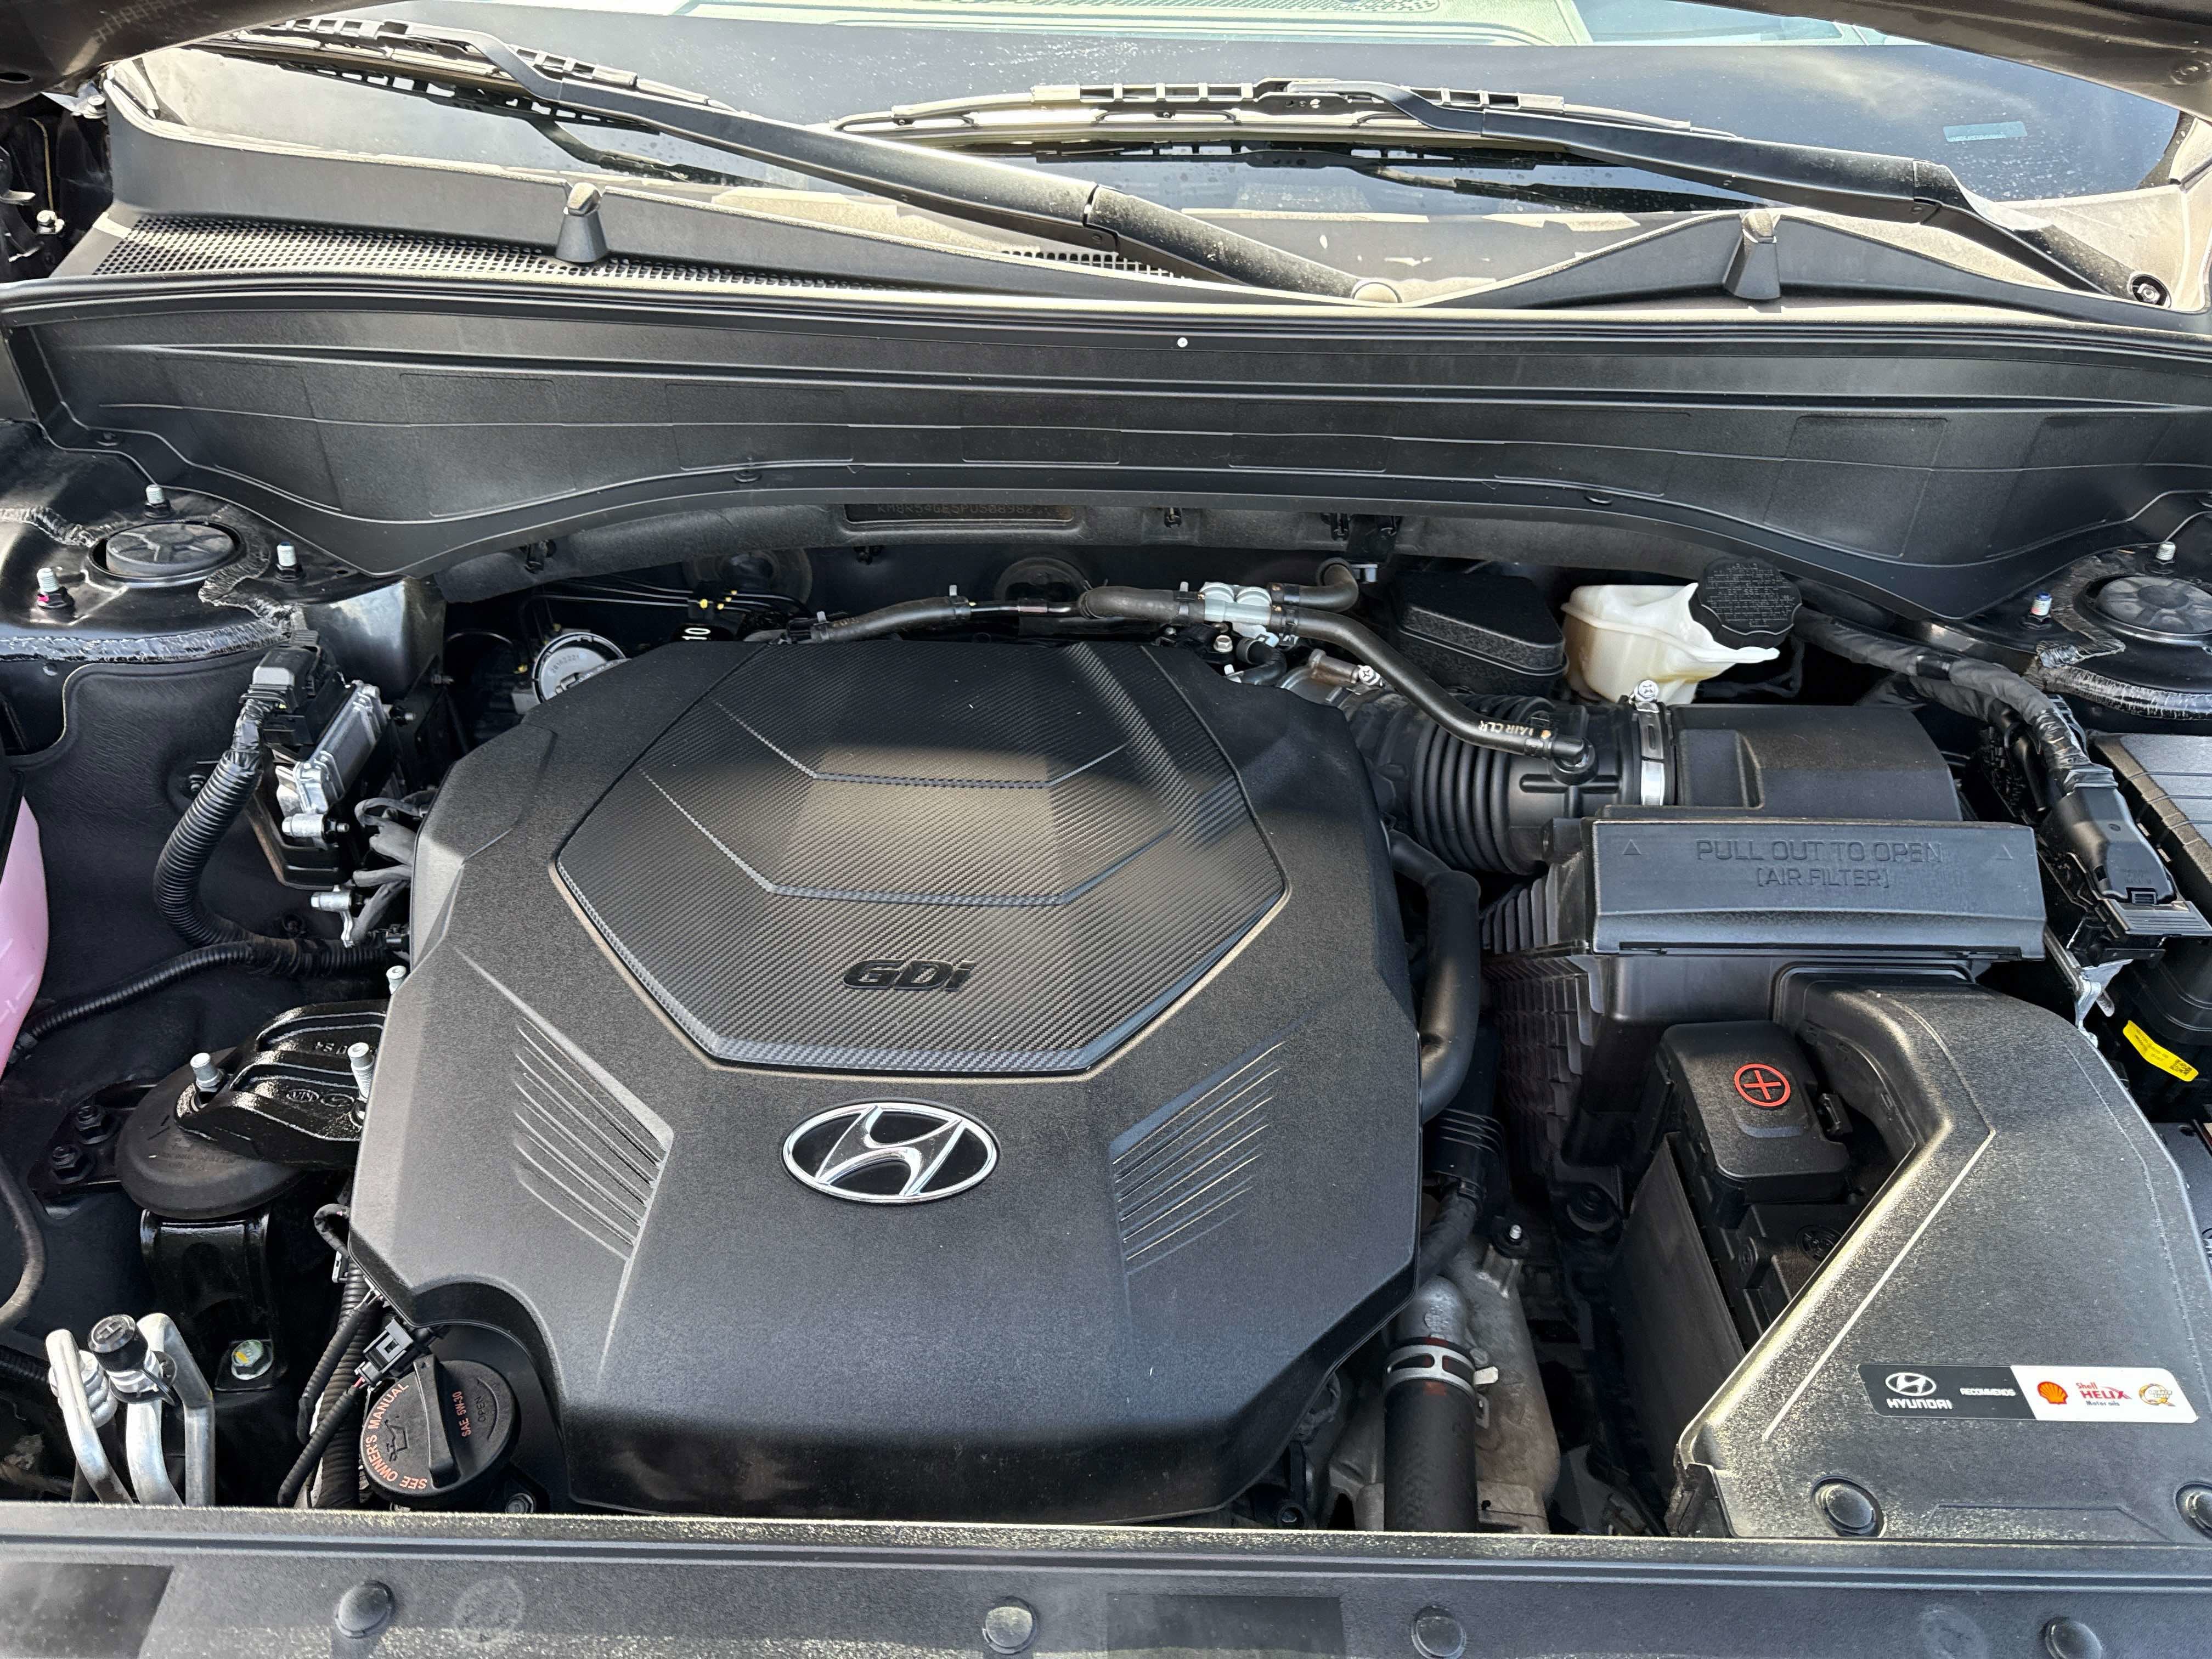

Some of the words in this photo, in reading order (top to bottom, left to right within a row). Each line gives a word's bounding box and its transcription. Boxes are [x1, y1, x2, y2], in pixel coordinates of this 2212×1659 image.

[1696, 838, 1765, 861] PULL
[1773, 839, 1825, 861] OUT
[1830, 839, 1865, 862] TO
[1873, 840, 1943, 863] OPEN
[368, 1383, 409, 1430] MANUAL
[452, 1390, 467, 1416] 5W-30
[1886, 1398, 1953, 1409] HYUNDAI
[2079, 1390, 2128, 1400] HELIX
[473, 1395, 487, 1423] OPEN
[459, 1418, 472, 1438] SAE
[365, 1434, 399, 1482] OWNER'S
[399, 1475, 428, 1490] SEE
